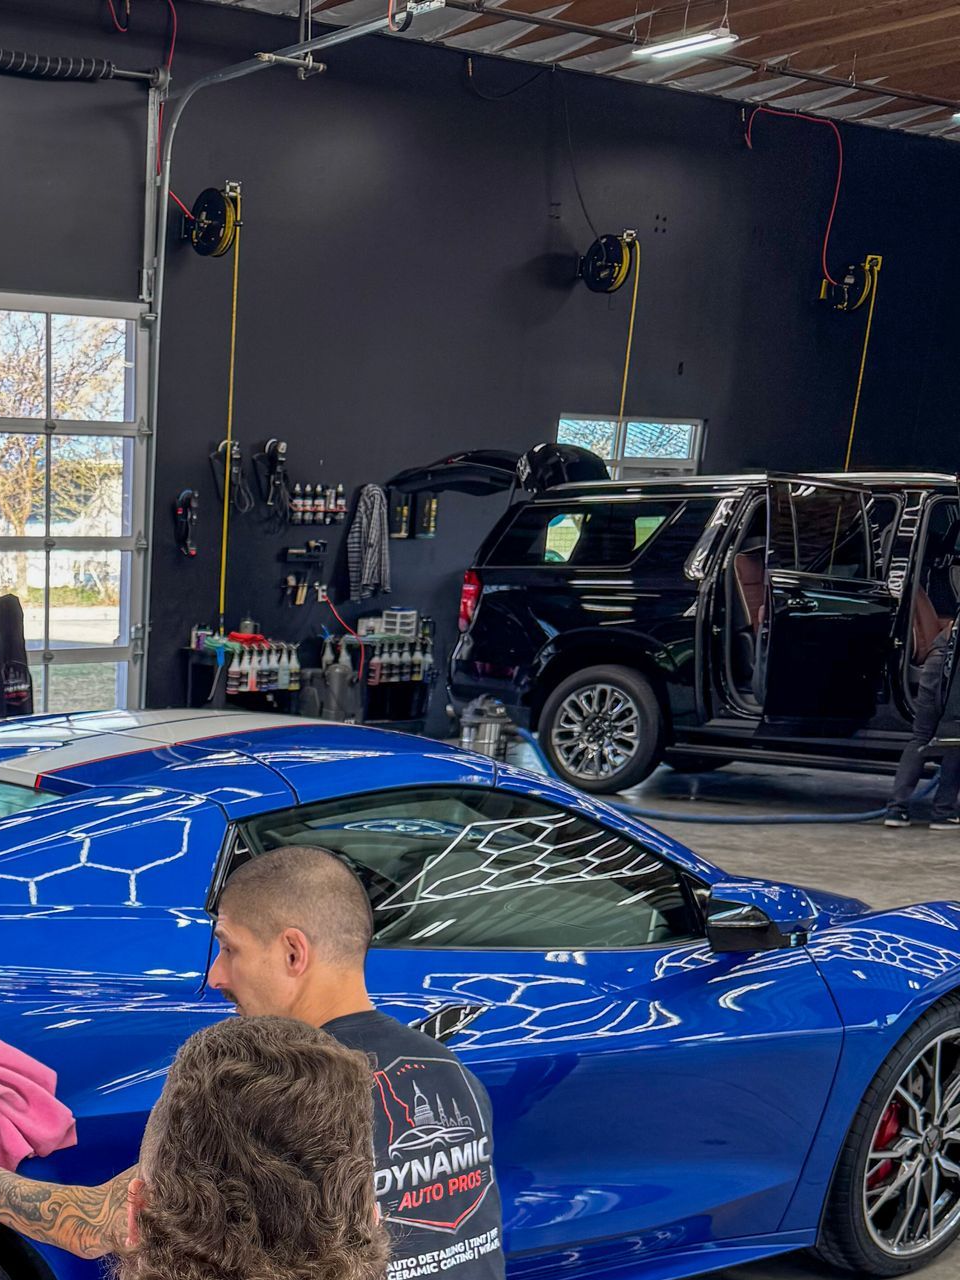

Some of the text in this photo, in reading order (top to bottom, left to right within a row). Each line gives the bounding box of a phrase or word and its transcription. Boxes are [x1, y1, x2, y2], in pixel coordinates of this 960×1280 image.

[374, 1136, 490, 1197] DYNAMIC
[397, 1169, 482, 1212] AUTO PROS
[386, 1256, 417, 1273] AUTO
